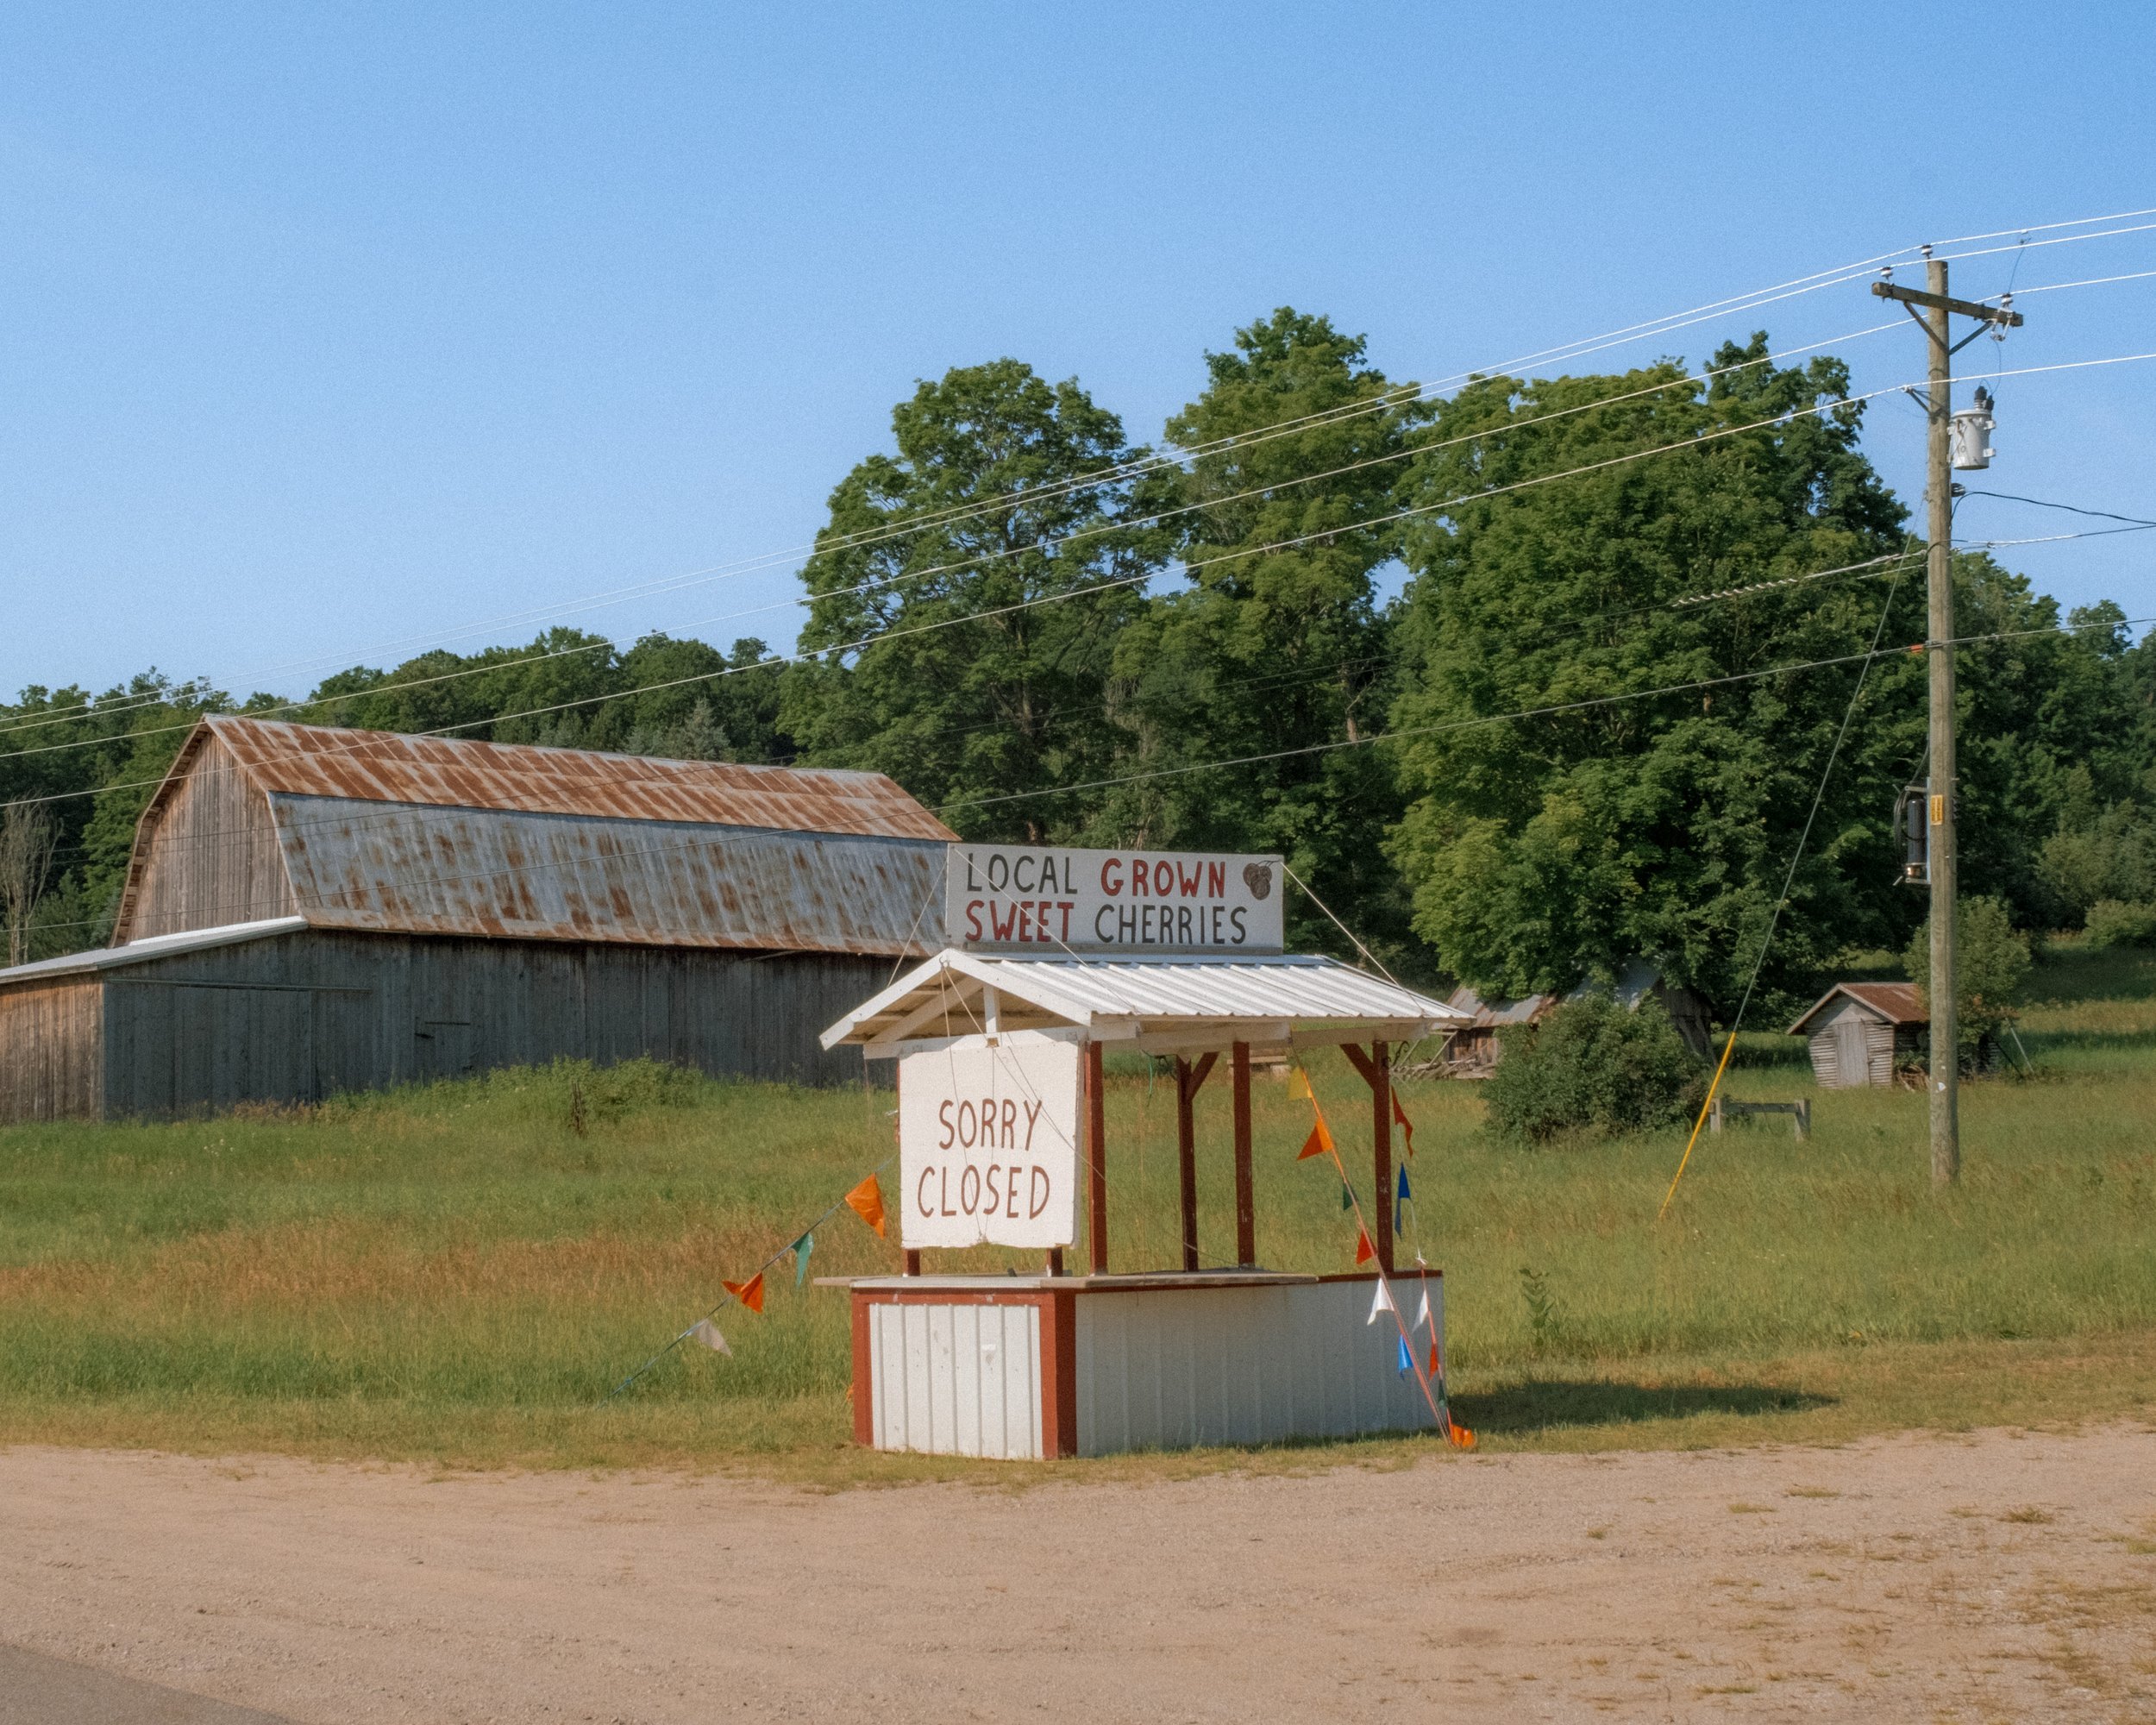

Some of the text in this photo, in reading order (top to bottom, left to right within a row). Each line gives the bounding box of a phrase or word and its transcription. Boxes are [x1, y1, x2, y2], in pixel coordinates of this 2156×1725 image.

[966, 852, 1225, 899] LOCAL GROWN
[965, 900, 1247, 944] SWEET CHERRIES
[938, 1098, 1043, 1151] SORRY
[917, 1164, 1050, 1220] CLOSED
